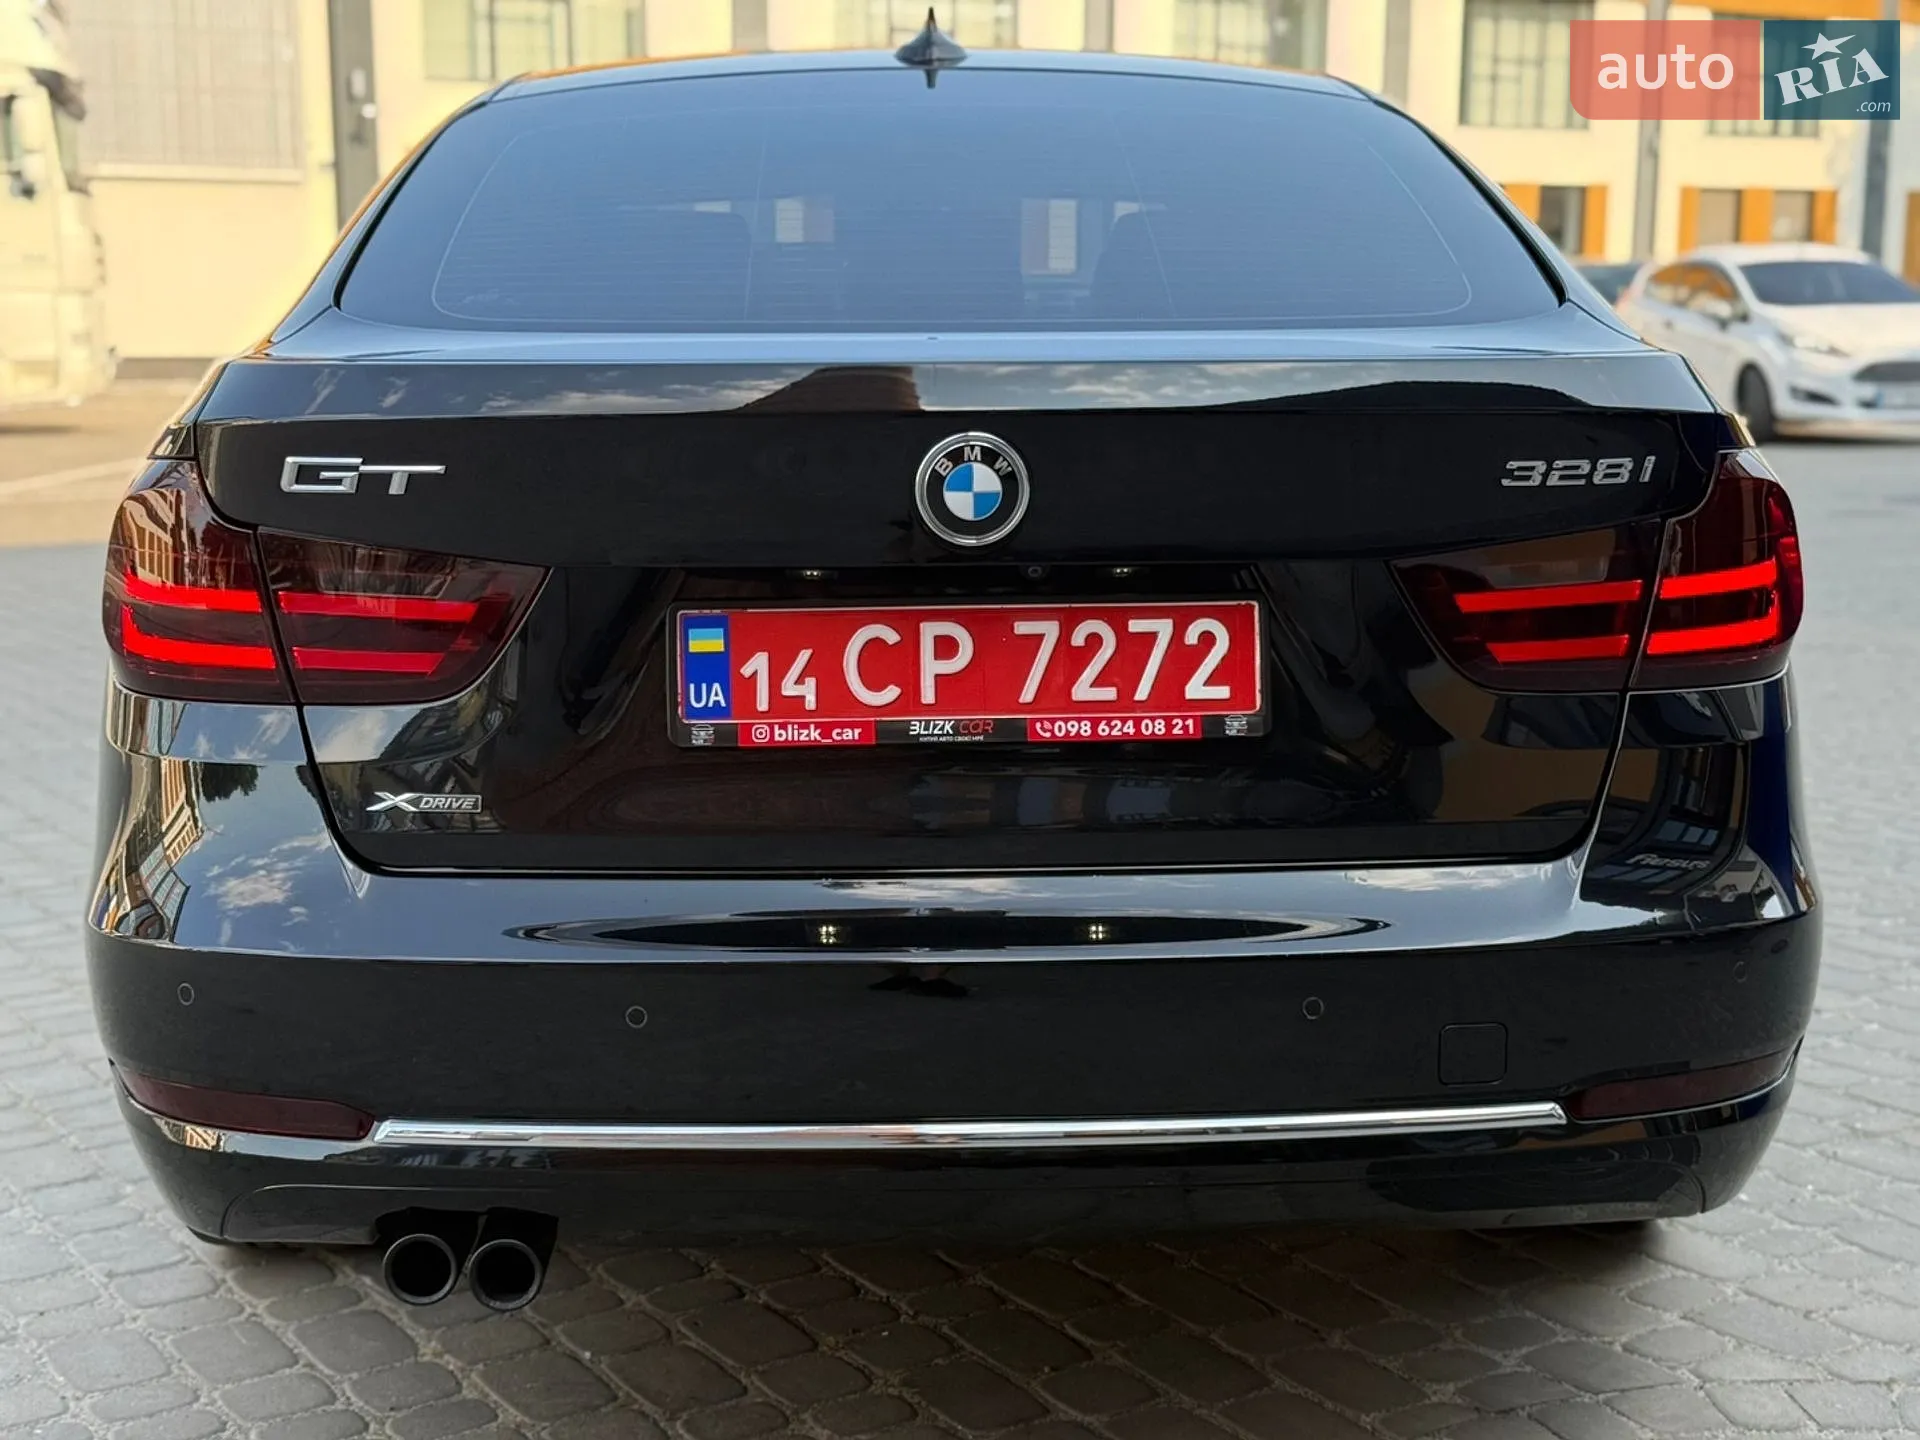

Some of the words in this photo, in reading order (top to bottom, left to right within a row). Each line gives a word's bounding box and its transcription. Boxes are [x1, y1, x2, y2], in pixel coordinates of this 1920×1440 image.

[279, 455, 447, 495] GT
[934, 445, 1012, 478] BMW
[740, 648, 817, 712] 14
[842, 621, 975, 707] CP
[1013, 619, 1231, 704] 7272
[689, 682, 726, 708] UA
[773, 724, 863, 744] blizk_car
[1053, 720, 1092, 737] 098
[1097, 720, 1136, 736] 624
[1140, 719, 1166, 735] 08
[1171, 718, 1195, 735] 21
